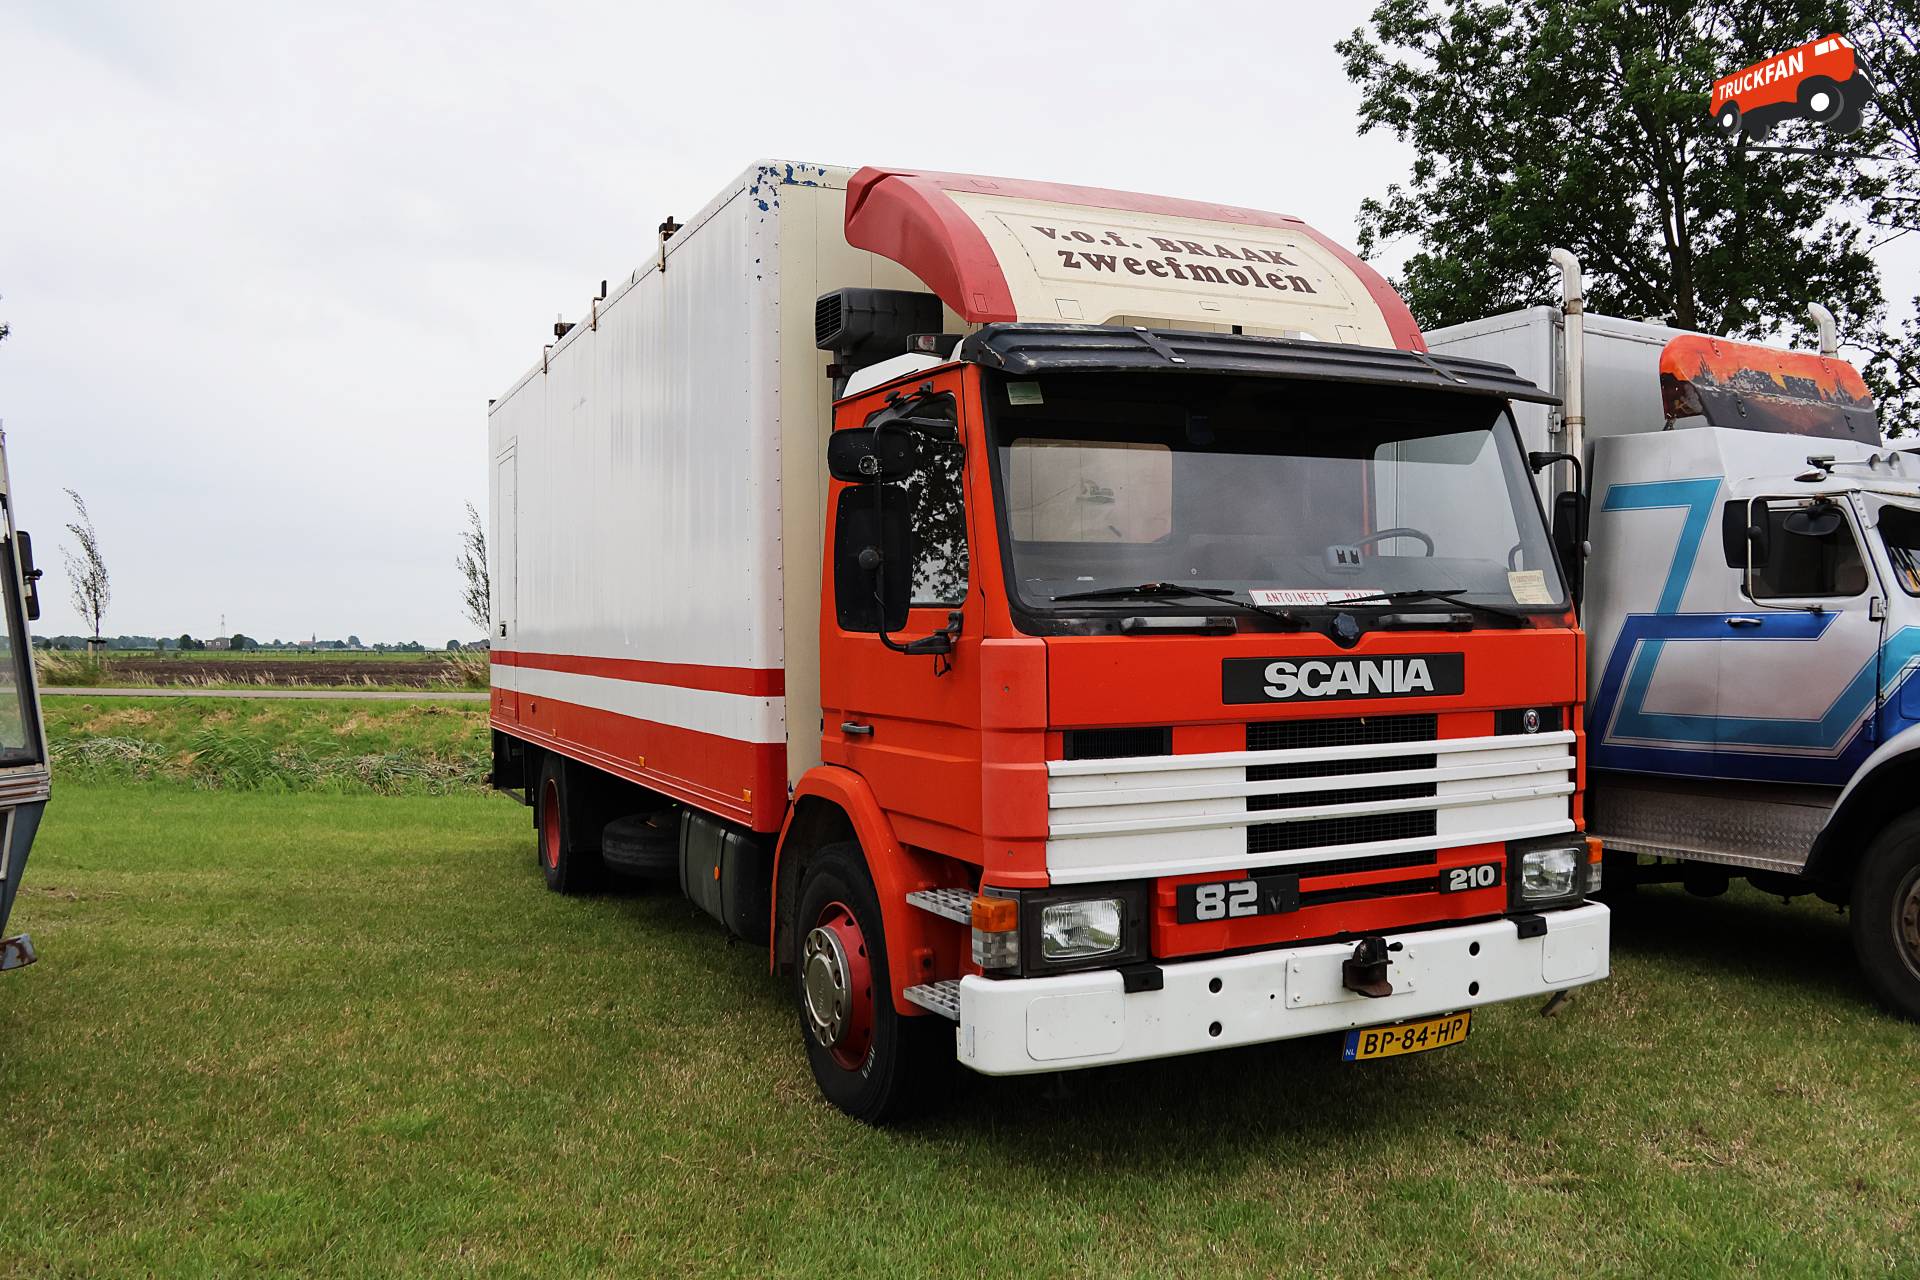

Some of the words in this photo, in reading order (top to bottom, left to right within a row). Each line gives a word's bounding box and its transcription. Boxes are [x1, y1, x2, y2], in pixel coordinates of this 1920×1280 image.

[1147, 236, 1299, 267] BRAAK
[1057, 249, 1318, 294] zweefmolen
[1265, 592, 1329, 603] ANTOINETTE
[1263, 658, 1435, 699] SCANIA
[1449, 864, 1496, 892] 210
[1195, 879, 1259, 921] 82
[1345, 1048, 1355, 1056] NL
[1363, 1018, 1463, 1055] BP-84-HP
